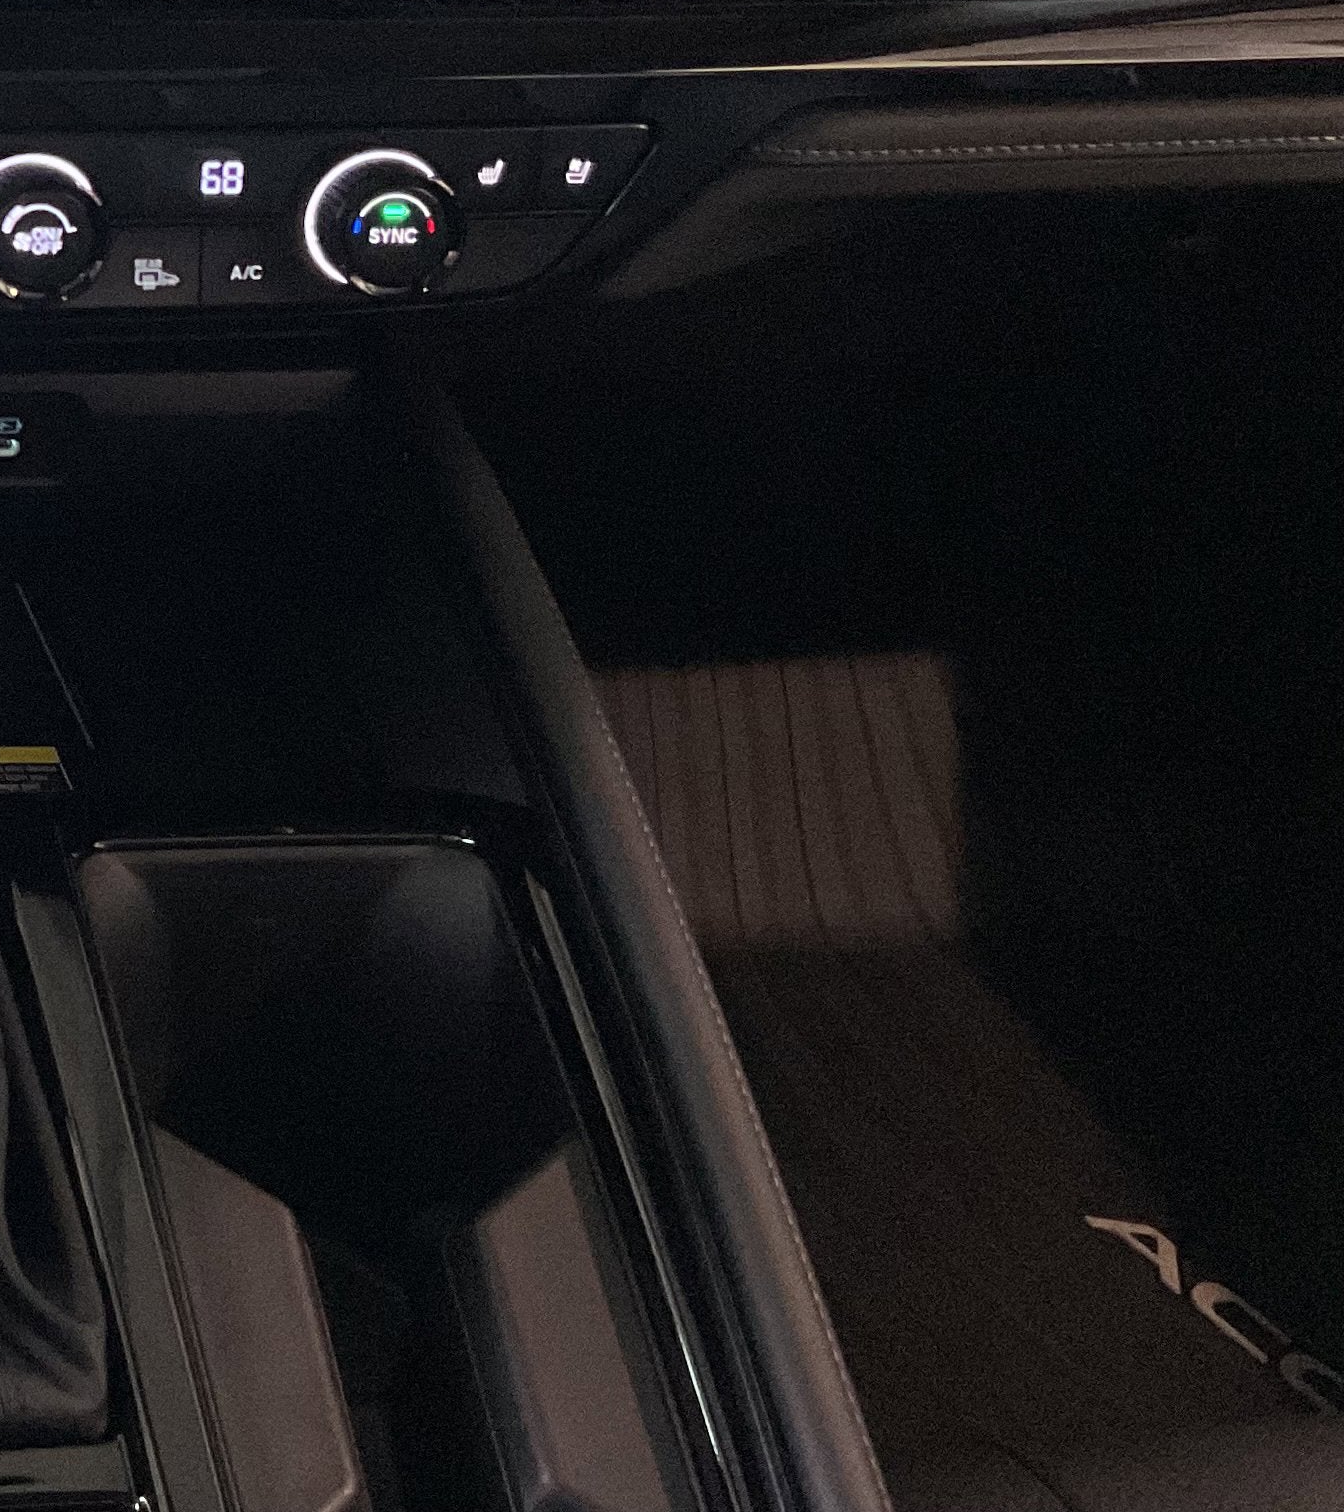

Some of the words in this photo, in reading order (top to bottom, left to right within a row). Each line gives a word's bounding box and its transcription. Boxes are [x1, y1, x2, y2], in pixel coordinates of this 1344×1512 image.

[199, 159, 245, 196] 68
[368, 226, 419, 245] SYNC
[230, 263, 263, 282] A/C
